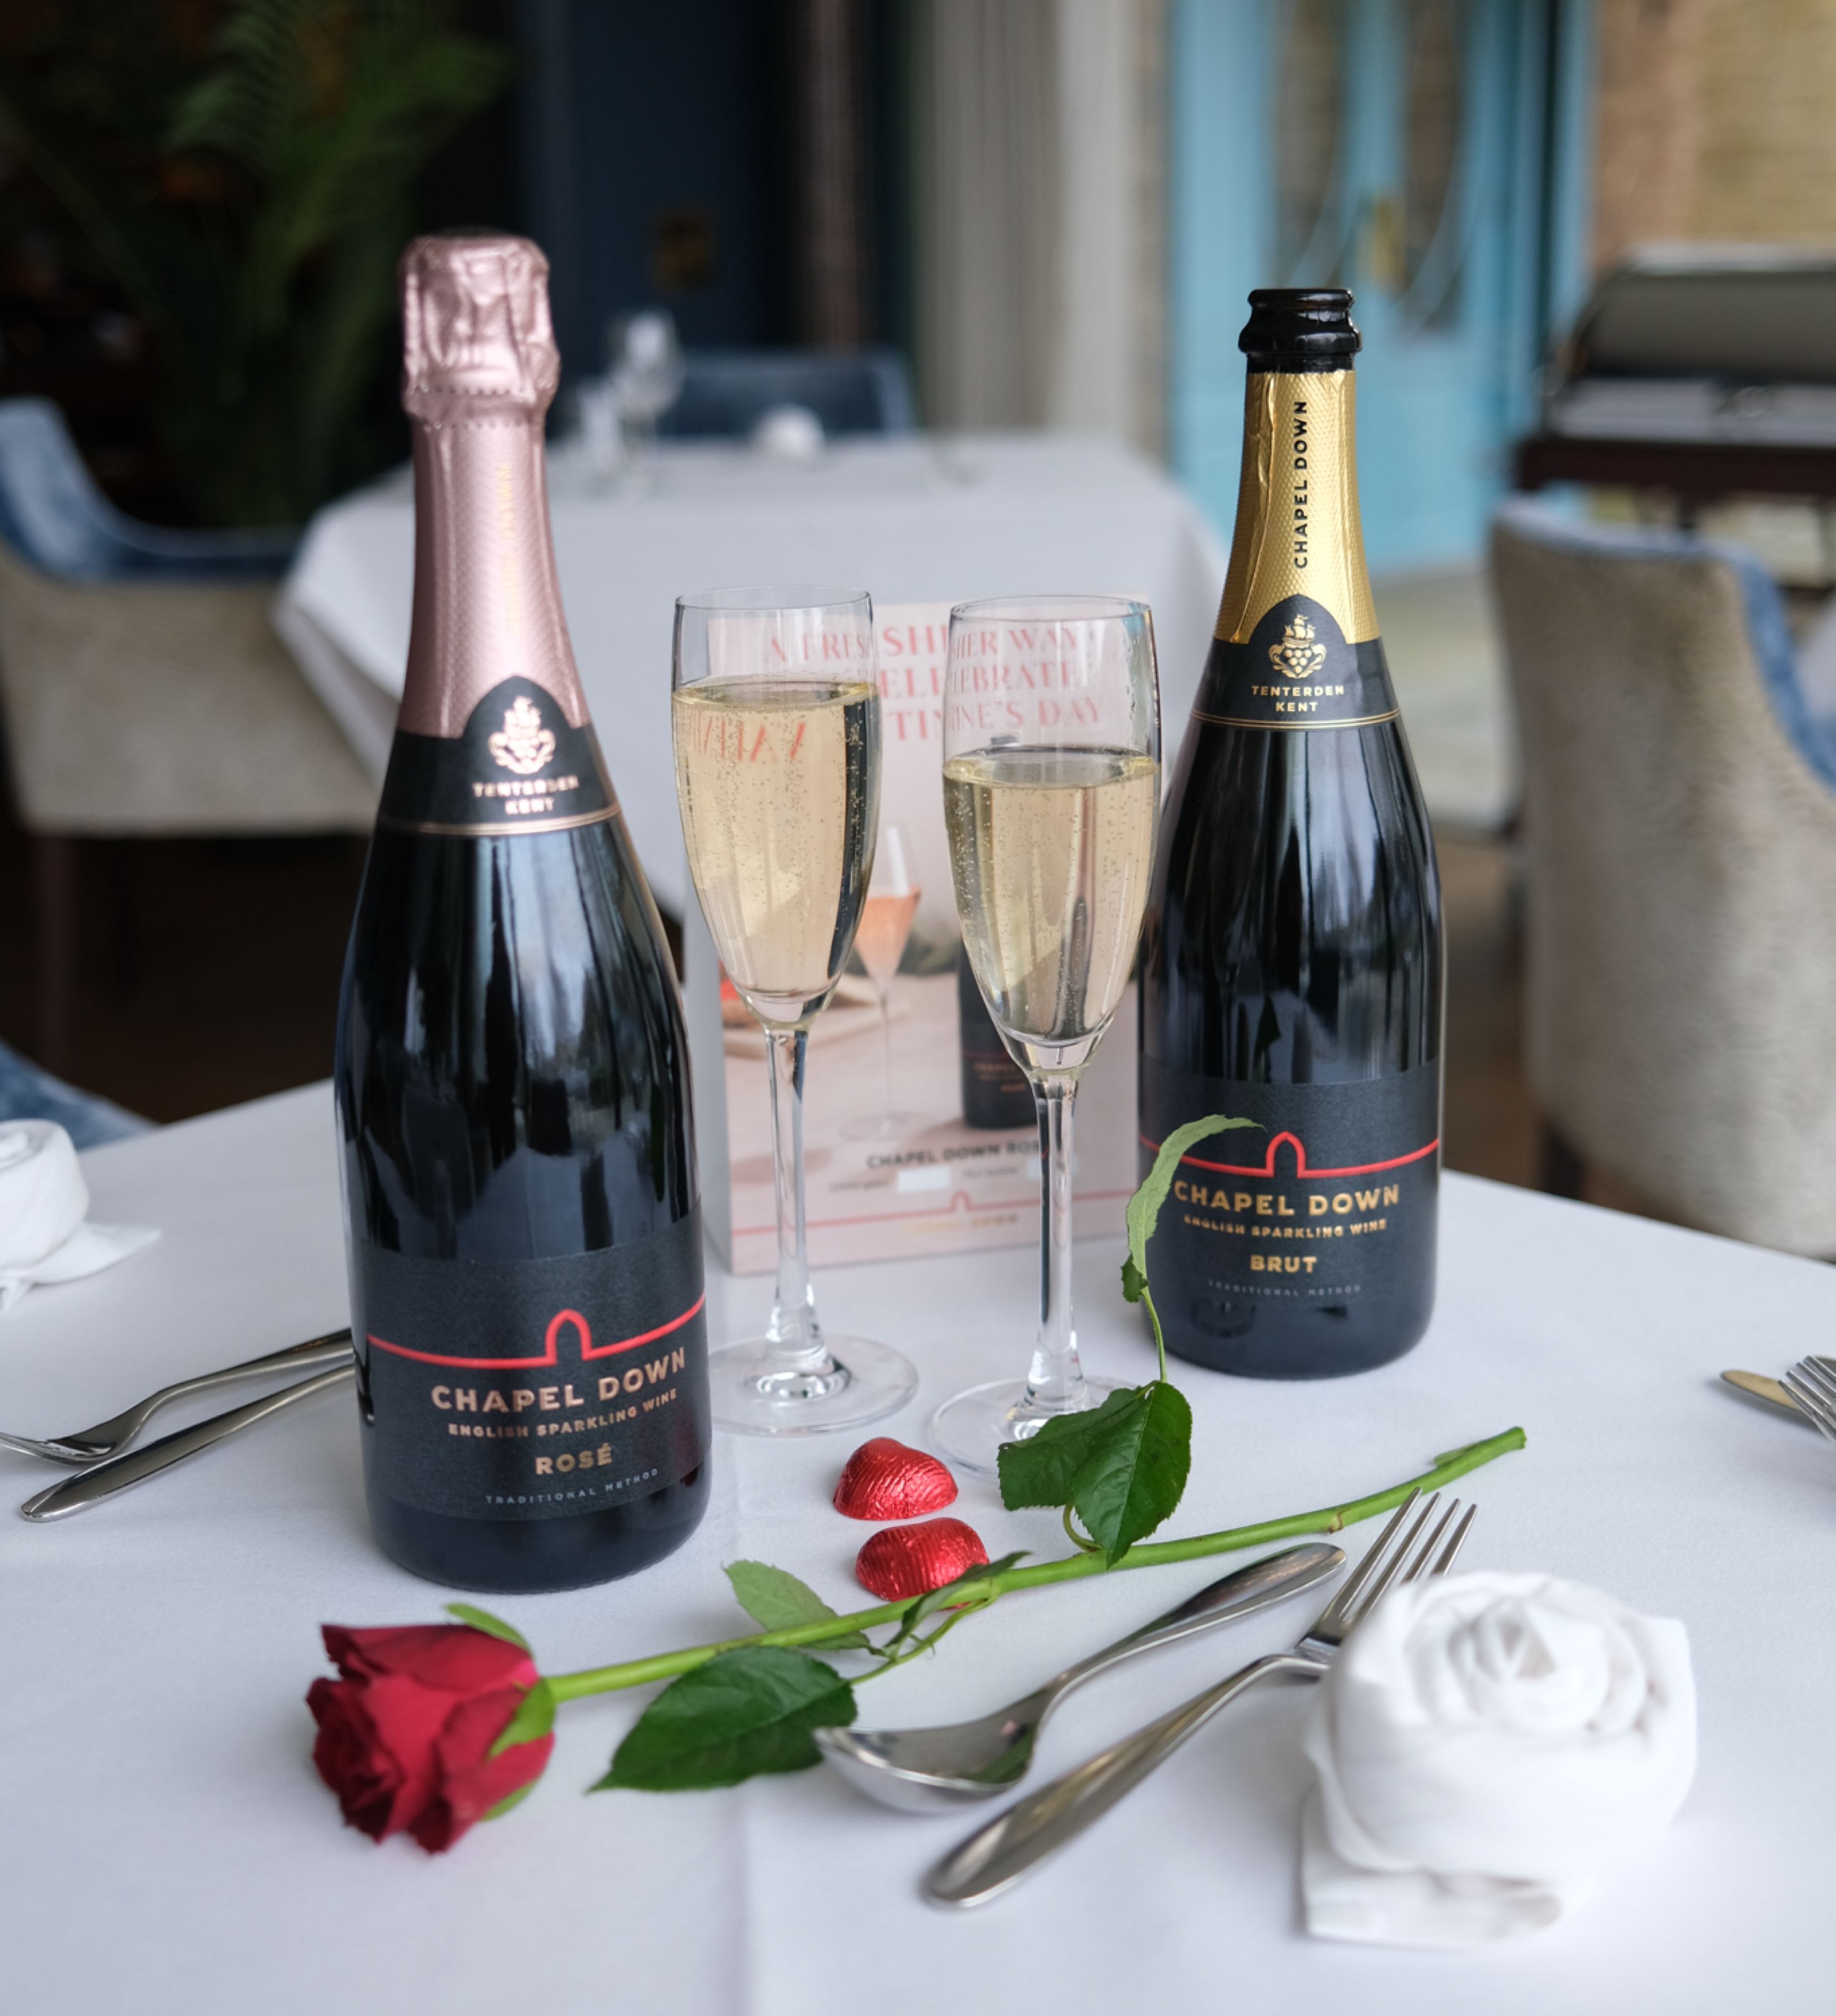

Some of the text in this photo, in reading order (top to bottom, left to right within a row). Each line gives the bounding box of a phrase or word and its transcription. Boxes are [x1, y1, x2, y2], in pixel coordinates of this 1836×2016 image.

[1293, 400, 1308, 569] CHAPEL DOWN
[1008, 627, 1077, 651] WAY
[1251, 685, 1344, 697] TENTERDEN
[1038, 697, 1099, 727] DAY
[1275, 701, 1318, 712] KENT
[473, 775, 579, 798] TENTERDEN
[505, 797, 554, 815] KENT
[867, 1140, 1040, 1168] CHAPEL DOWN ROS
[1174, 1181, 1399, 1216] CHAPEL DOWN
[1184, 1214, 1386, 1238] ENGLISH SPARKLING WINE
[1250, 1255, 1317, 1273] BRUT
[1208, 1280, 1361, 1296] TRADITIONAL METHOD
[431, 1346, 685, 1413] CHAPEL DOWN
[448, 1388, 677, 1438] ENGLISH SPARKLING WINE
[535, 1443, 612, 1475] ROSÉ
[485, 1468, 659, 1505] TRADITIONAL METHOD
